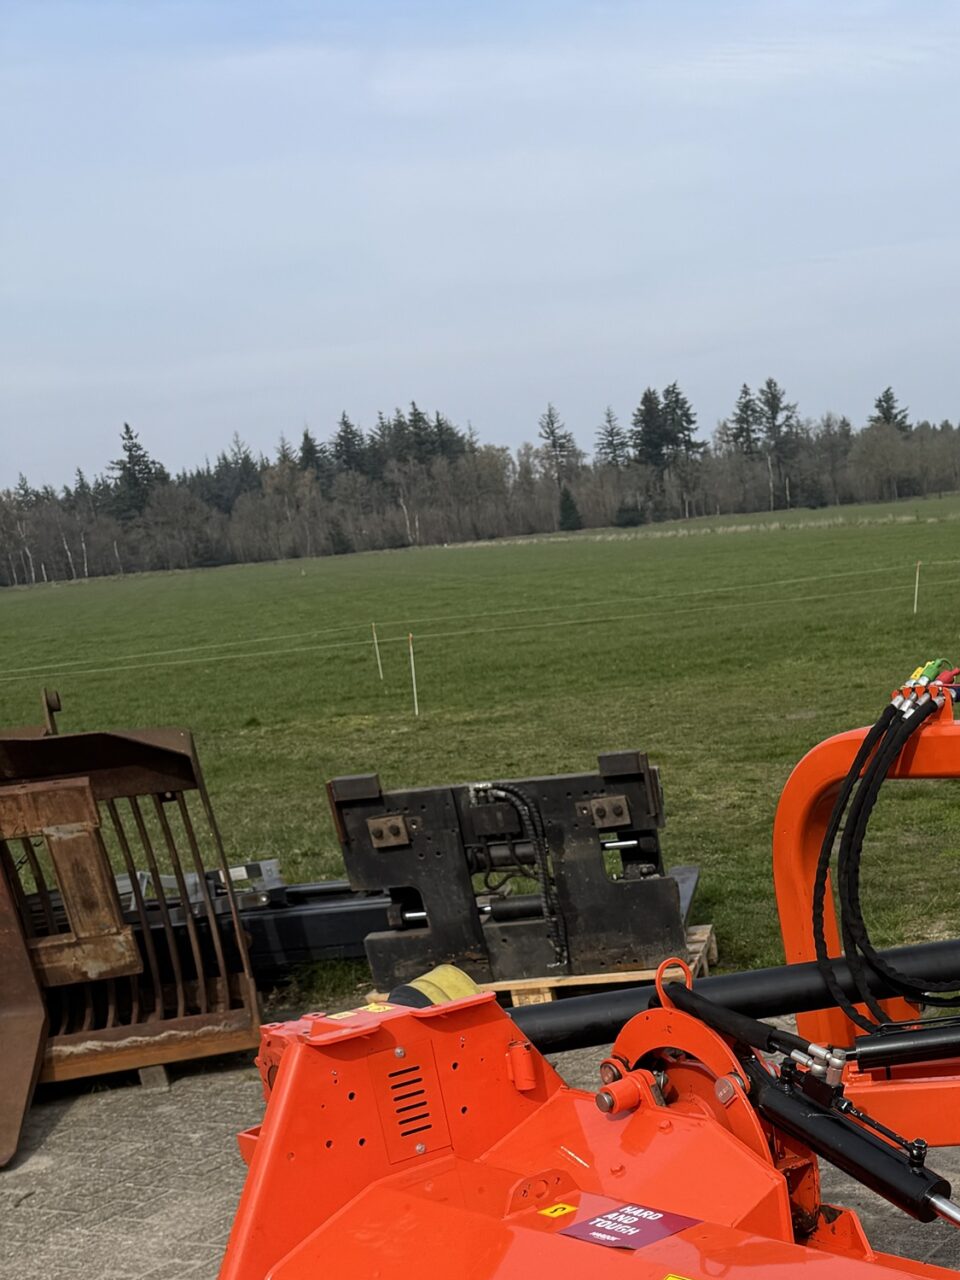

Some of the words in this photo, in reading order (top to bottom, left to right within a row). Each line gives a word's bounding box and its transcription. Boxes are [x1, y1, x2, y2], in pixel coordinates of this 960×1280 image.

[603, 1212, 639, 1224] AND
[619, 1205, 664, 1221] HARD
[588, 1217, 641, 1236] TOUGH
